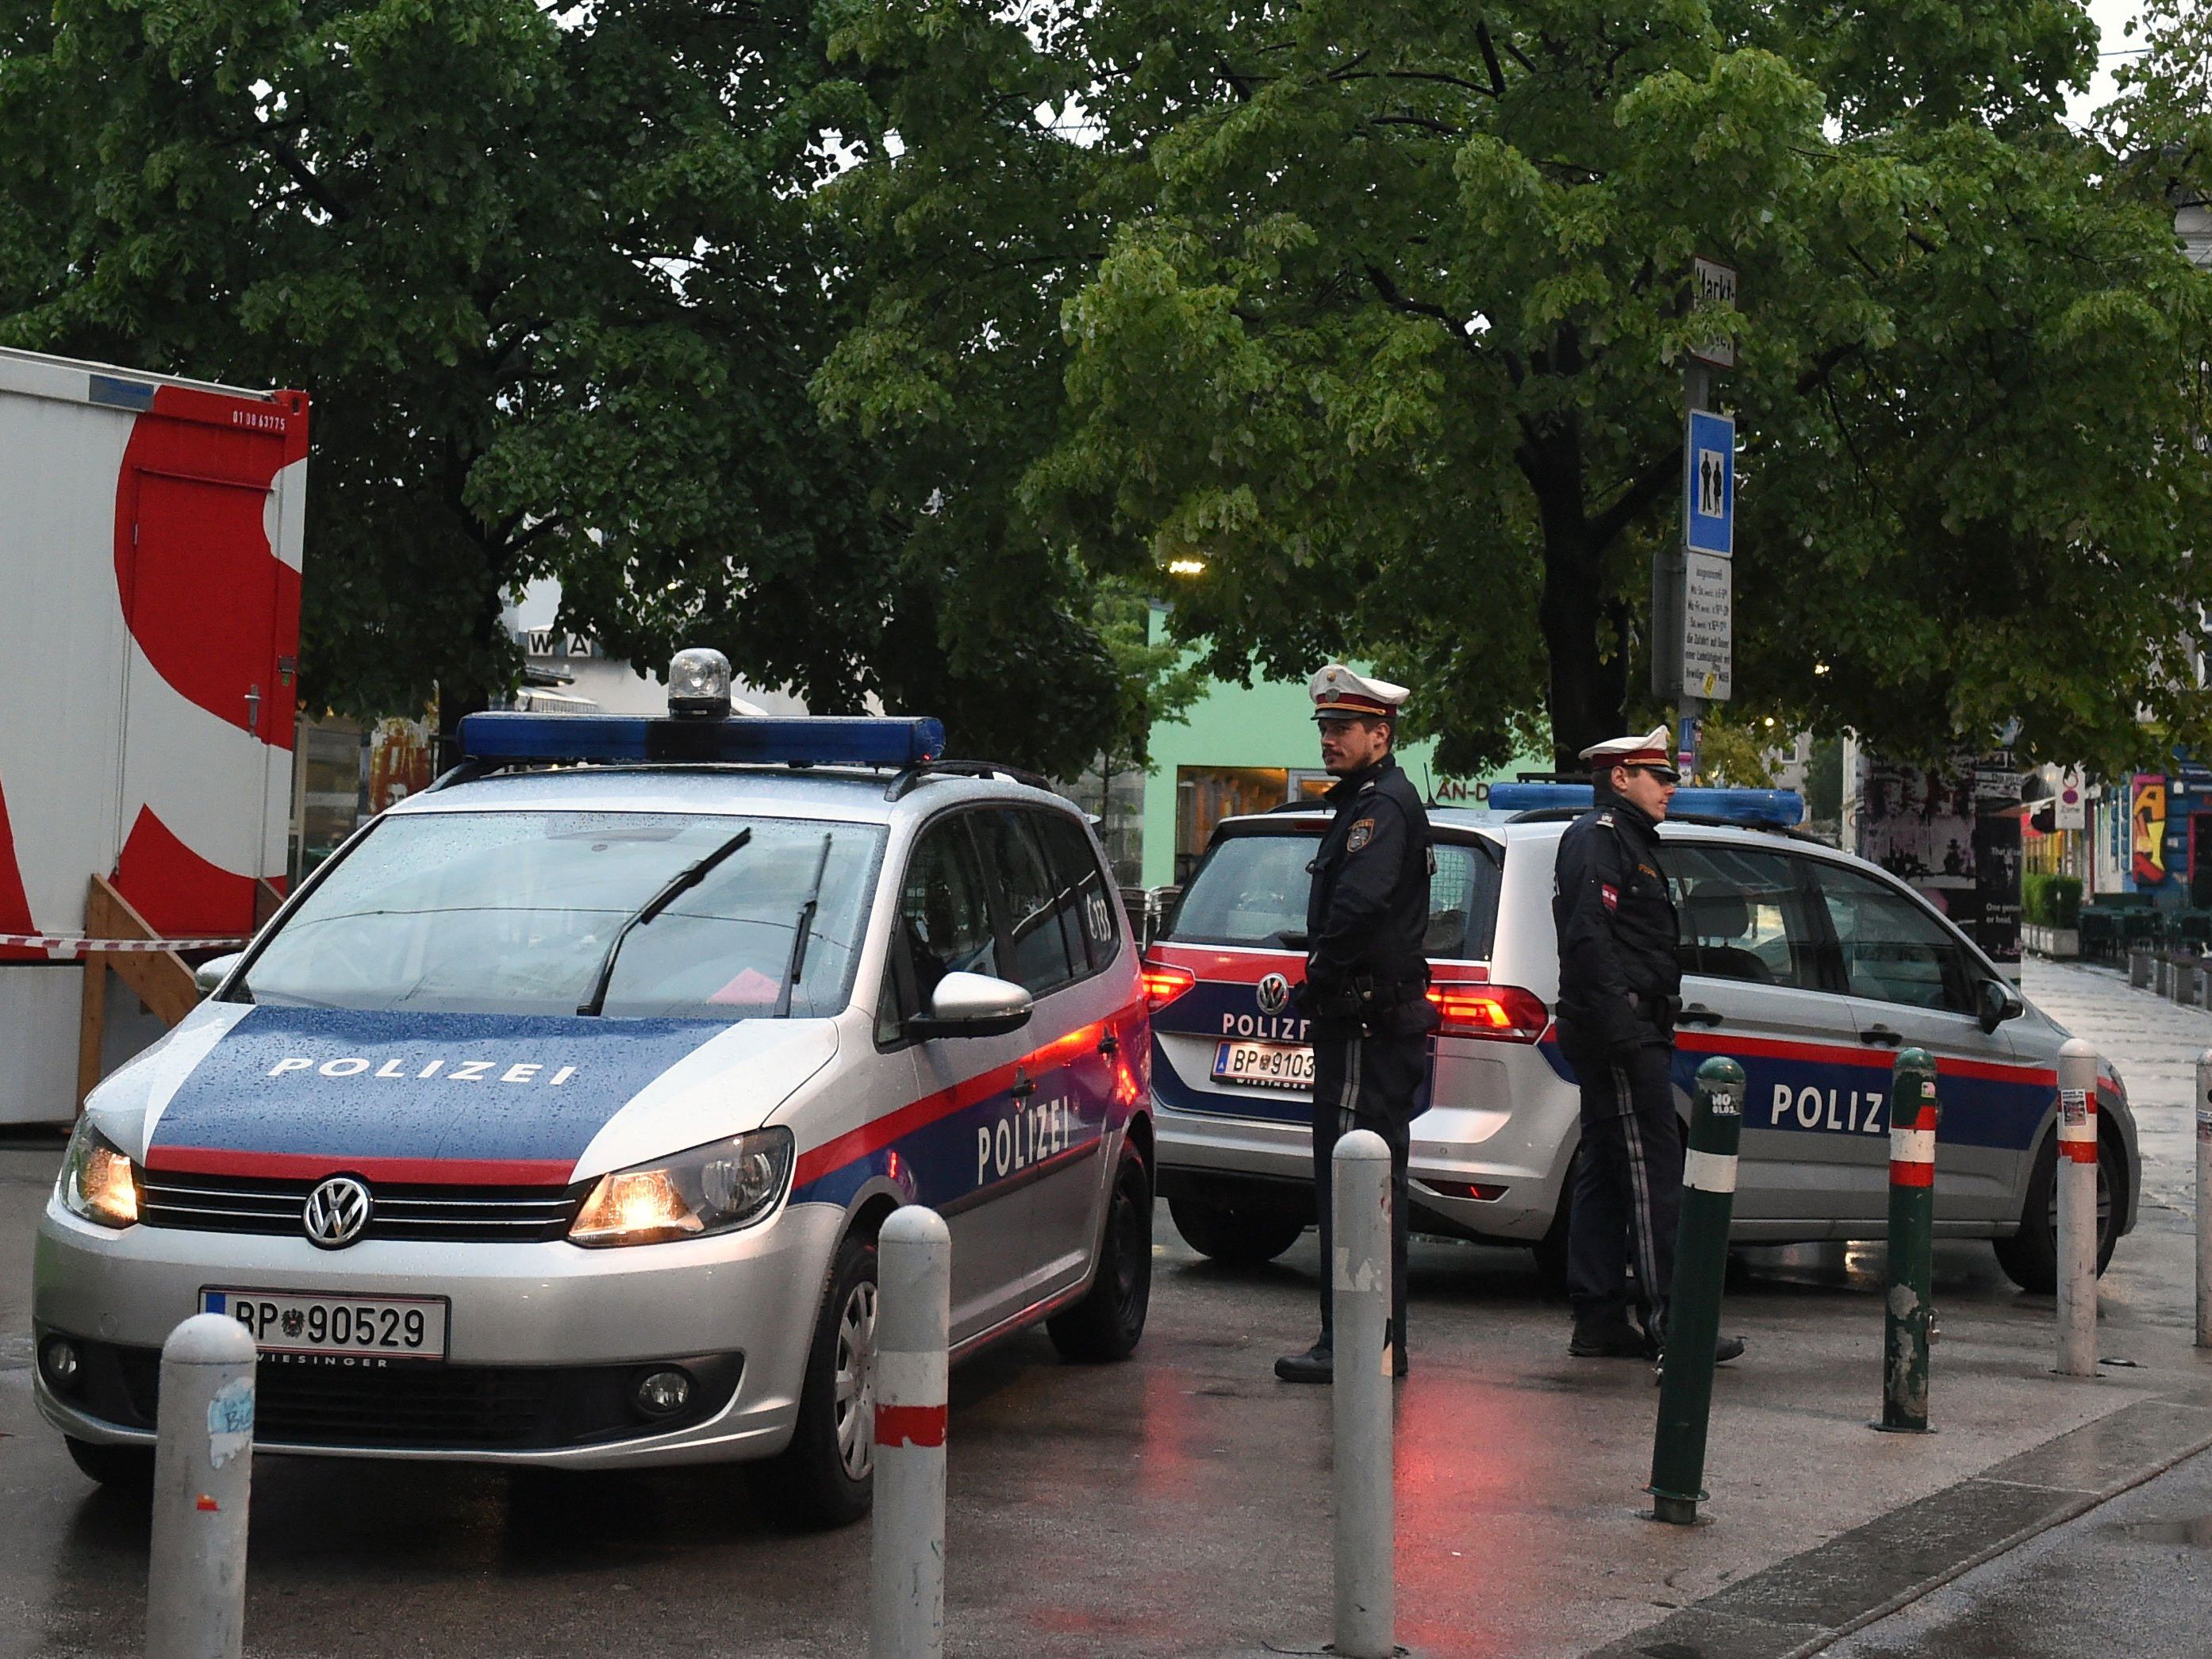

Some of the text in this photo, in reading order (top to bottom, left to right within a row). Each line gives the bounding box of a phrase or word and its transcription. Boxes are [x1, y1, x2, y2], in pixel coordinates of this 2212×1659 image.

[258, 414, 286, 431] 63775
[1223, 1012, 1311, 1040] POLIZE
[267, 1057, 578, 1085] POLIZEI
[1233, 1049, 1258, 1073] BP
[1270, 1052, 1314, 1078] 9103
[1770, 1083, 1884, 1134] POLIZ
[977, 1095, 1069, 1186] POLIZEI
[307, 1304, 425, 1348] 90529
